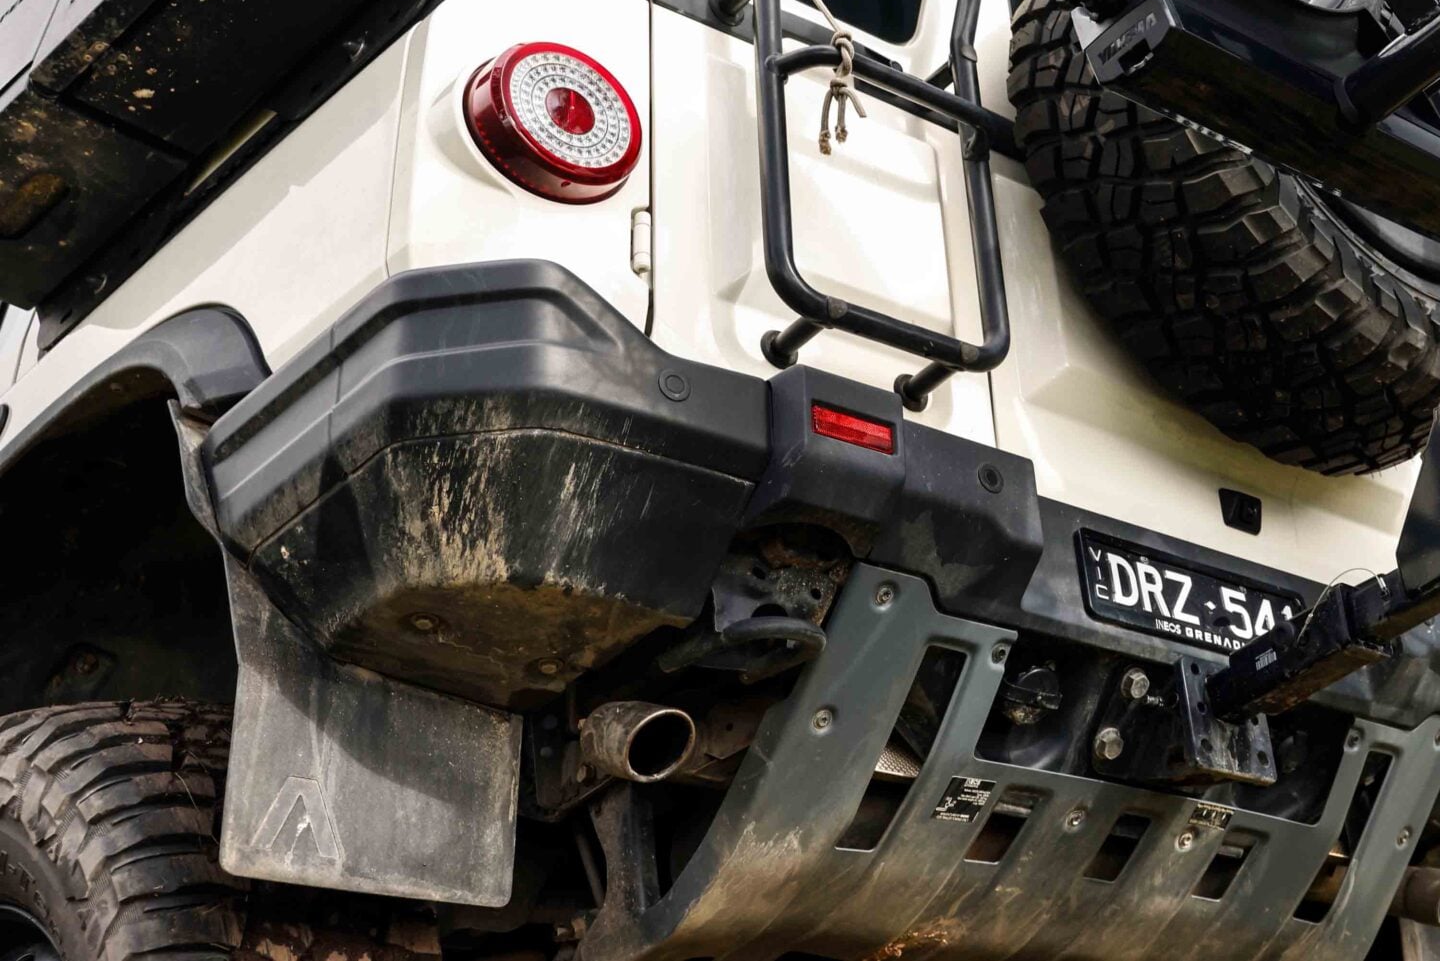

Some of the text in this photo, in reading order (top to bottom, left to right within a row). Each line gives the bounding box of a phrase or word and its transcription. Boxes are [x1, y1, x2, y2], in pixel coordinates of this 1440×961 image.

[1088, 546, 1110, 601] VIC
[1155, 618, 1246, 651] INEOS GRENAD
